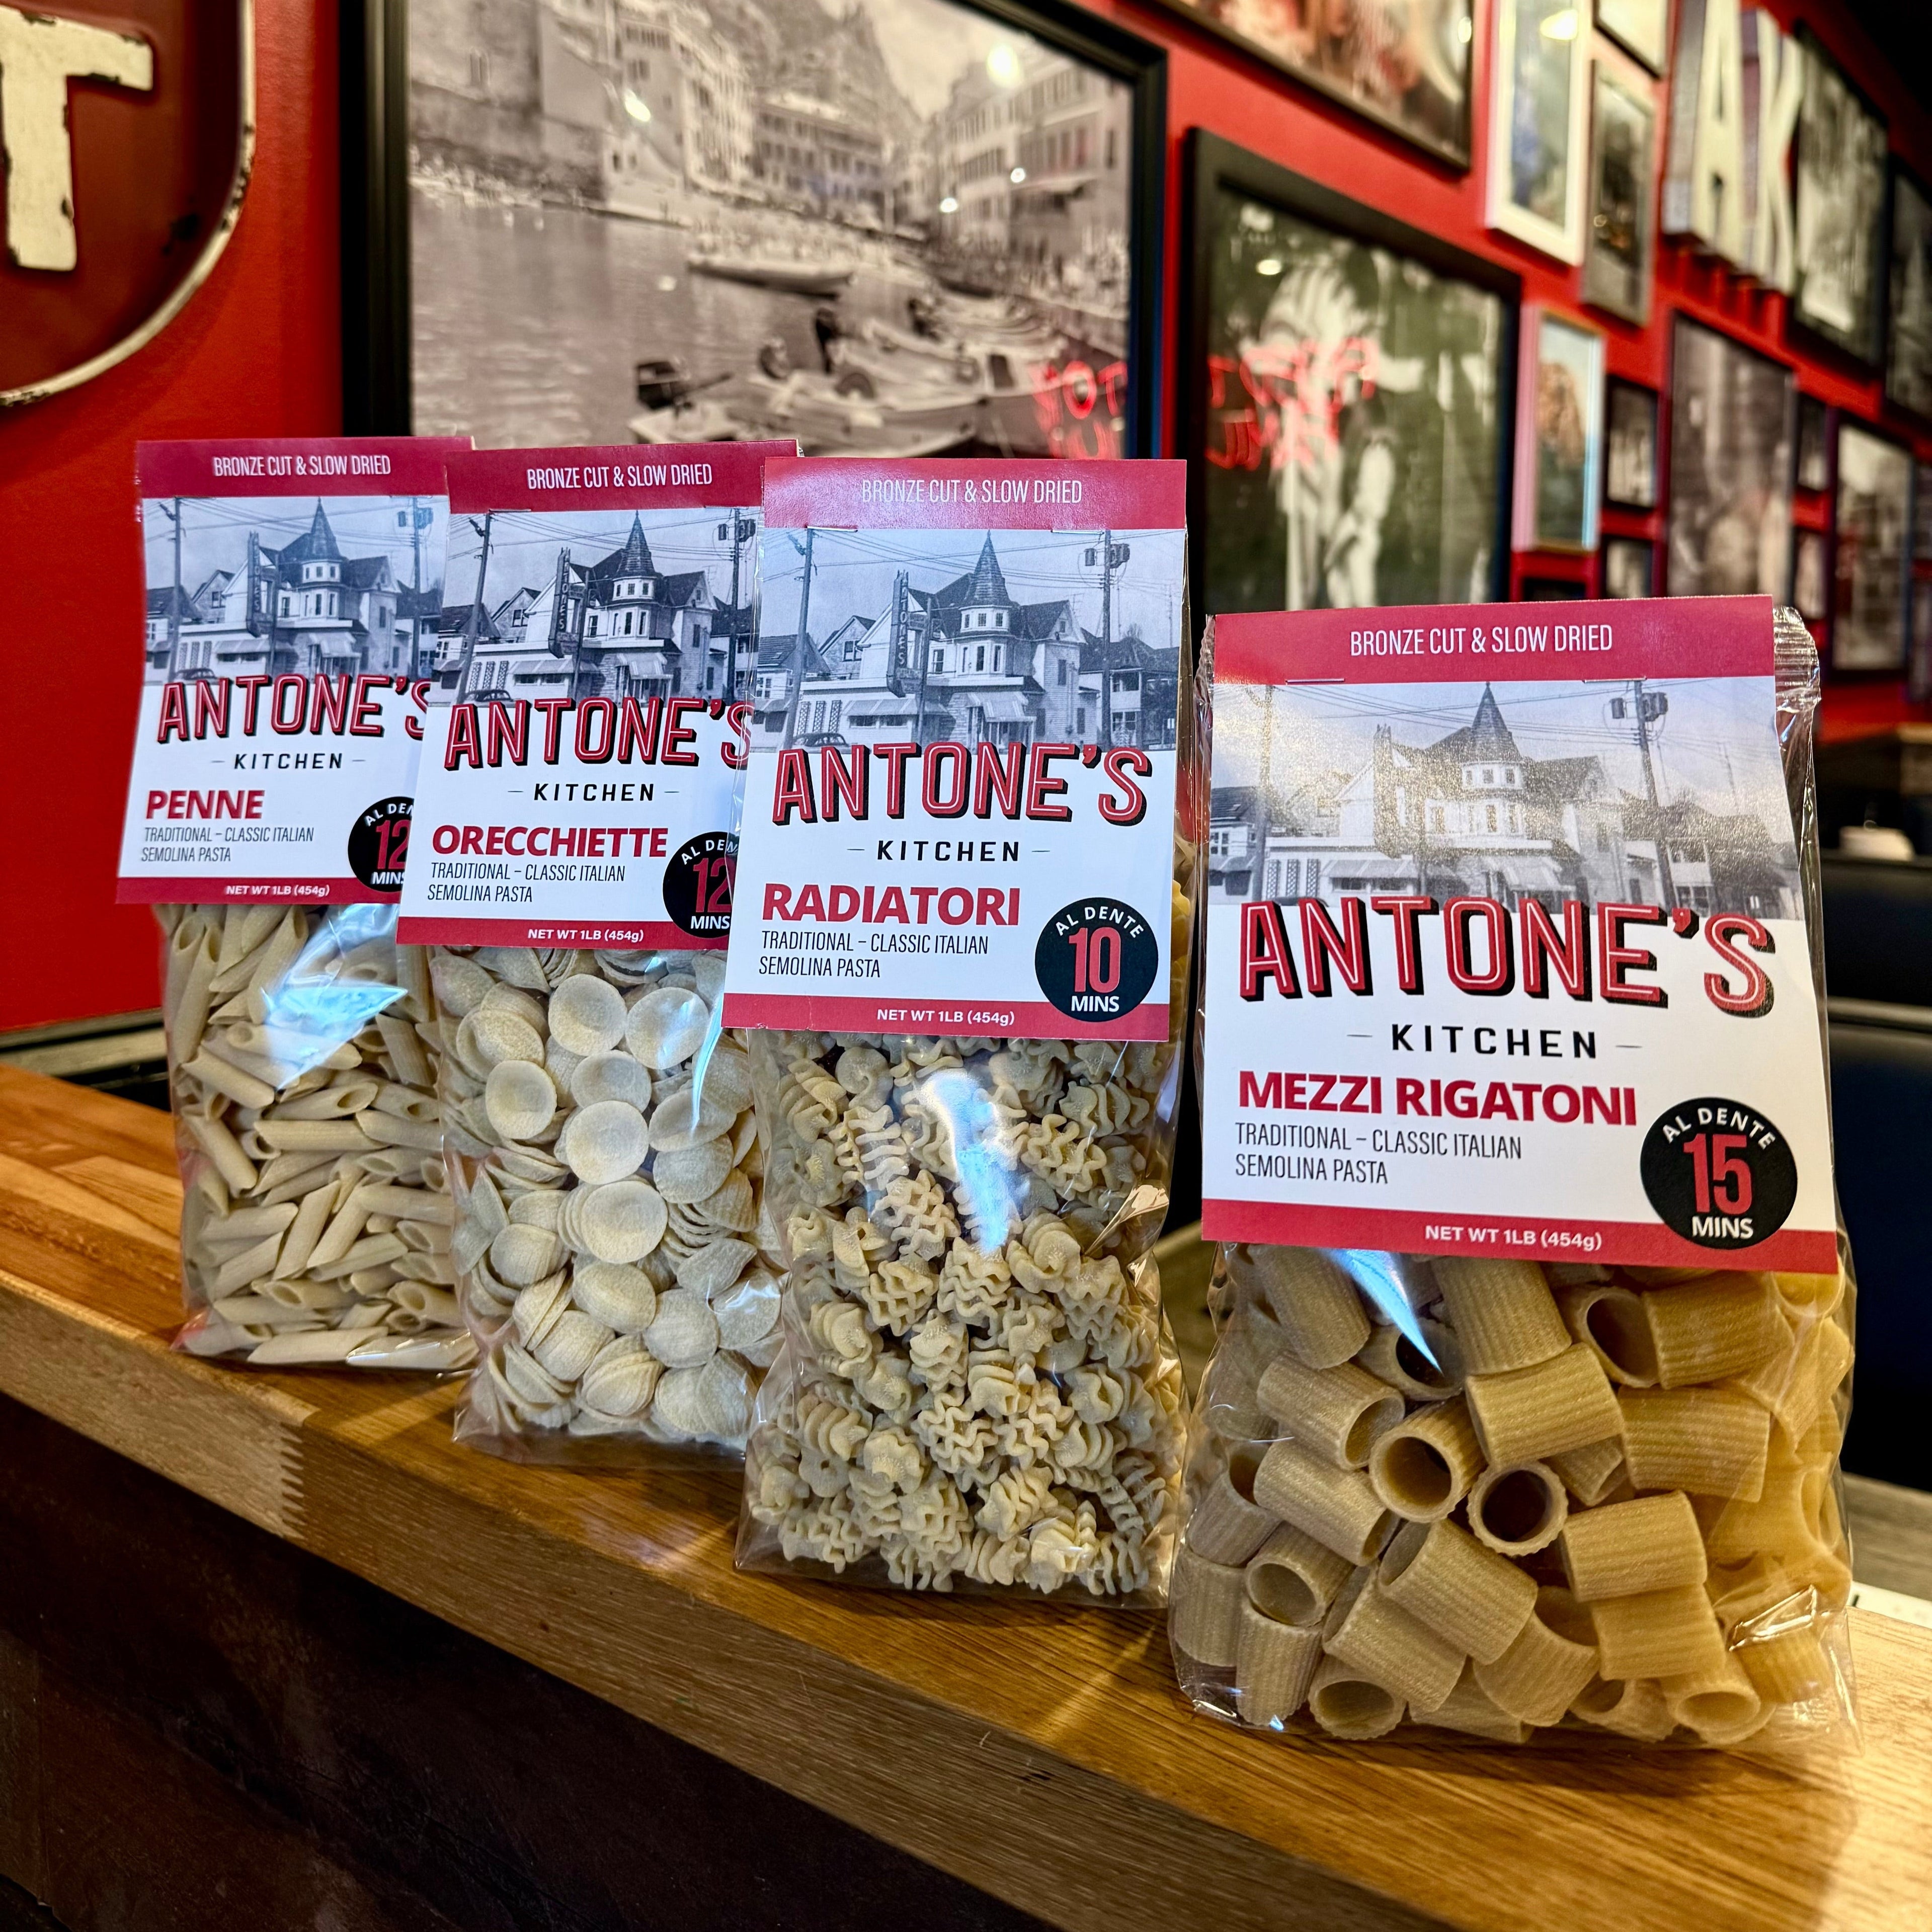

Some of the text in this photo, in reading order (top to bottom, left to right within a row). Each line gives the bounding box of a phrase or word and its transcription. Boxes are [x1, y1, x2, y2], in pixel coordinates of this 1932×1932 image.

[213, 455, 391, 476] BRONZE CUT & SLOW DRIED
[527, 463, 712, 490] BRONZE CUT & SLOW DRIED
[862, 479, 1082, 504] BRONZE CUT & SLOW DRIED
[1350, 624, 1613, 657] BRONZE CUT & SLOW DRIED
[444, 697, 756, 771] ANTONE'S
[234, 753, 343, 770] KITCHEN
[534, 783, 654, 801] KITCHEN
[772, 742, 1153, 827] ANTONE'S
[146, 790, 265, 820] PENNE
[365, 809, 383, 827] AL
[144, 827, 212, 842] TRADITIONAL
[225, 827, 270, 842] CLASSIC
[273, 827, 314, 842] ITALIAN
[376, 820, 412, 869] 12
[432, 825, 668, 857] ORECCHIETTE
[141, 847, 231, 862] SEMOLINA PASTA
[681, 846, 700, 865] AL
[877, 840, 1019, 861] KITCHEN
[431, 862, 510, 880] TRADITIONAL
[525, 864, 577, 881] CLASSIC
[580, 865, 625, 882] ITALIAN
[693, 857, 737, 913] 12
[226, 886, 330, 897] NET WT 1LB (454g)
[427, 884, 533, 902] SEMOLINA PASTA
[762, 883, 1019, 925] RADIATORI
[690, 916, 730, 929] MINS
[1056, 906, 1144, 938] AL DENTE
[528, 929, 644, 942] NET WT 1LB (454g)
[762, 931, 854, 952] TRADITIONAL
[870, 933, 931, 953] CLASSIC
[934, 935, 988, 954] ITALIAN
[759, 956, 880, 978] SEMOLINA PASTA
[1069, 927, 1121, 993] 10
[1239, 895, 1775, 1018] ANTONE'S
[1071, 996, 1119, 1012] MINS
[877, 1009, 1014, 1026] NET WT 1LB (454g)
[1391, 1023, 1597, 1058] KITCHEN
[1239, 1070, 1637, 1126] MEZZI RIGATONI
[1235, 1122, 1351, 1150] TRADITIONAL
[1372, 1130, 1448, 1156] CLASSIC
[1453, 1133, 1521, 1159] ITALIAN
[1662, 1107, 1776, 1150] AL DENTE
[1235, 1153, 1388, 1184] SEMOLINA PASTA
[1683, 1133, 1752, 1215] 15
[1425, 1224, 1602, 1251] NET WT 1LB (454g)
[1692, 1216, 1753, 1239] MINS
